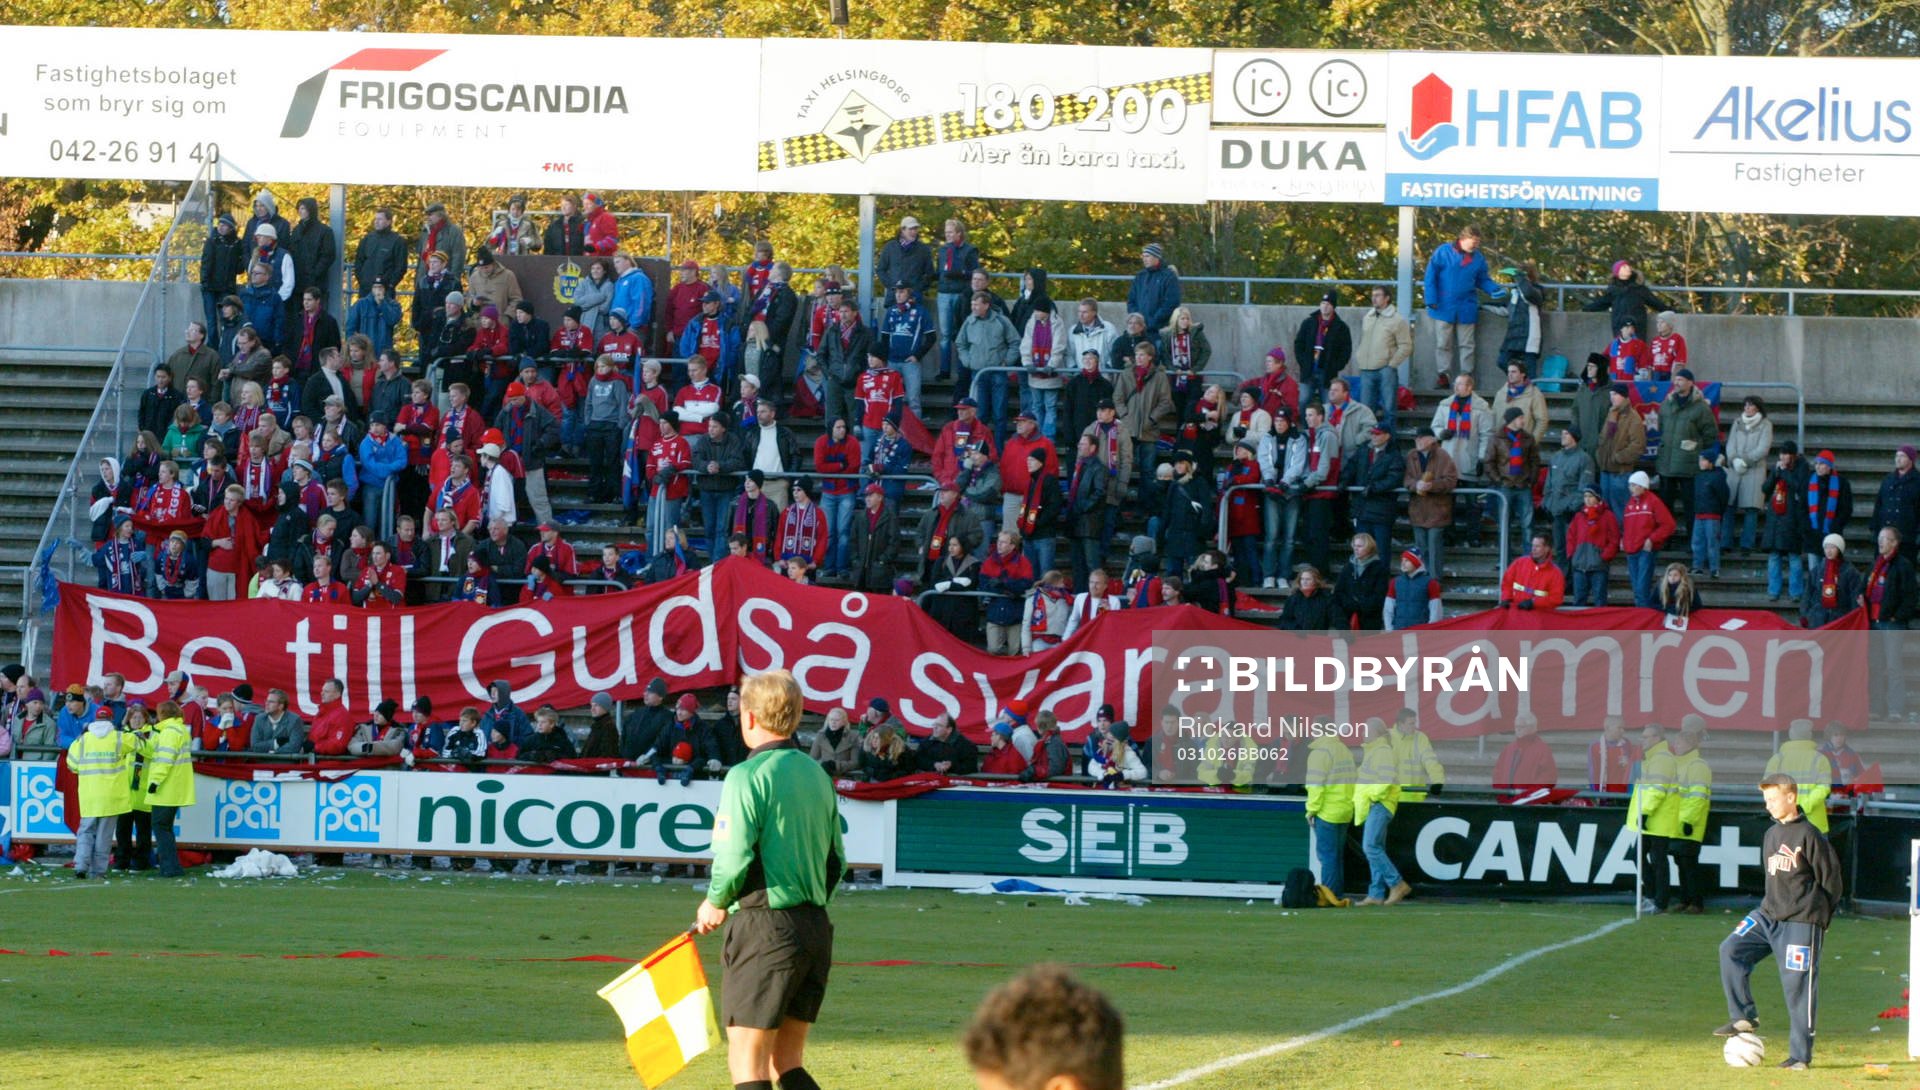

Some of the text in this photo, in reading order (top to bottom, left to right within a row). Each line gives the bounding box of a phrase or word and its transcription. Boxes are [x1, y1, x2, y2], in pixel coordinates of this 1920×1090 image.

[36, 64, 237, 89] Fastighetsbolaget
[44, 95, 226, 119] som bryr sig om
[340, 81, 629, 114] FRIGOSCANDIA
[797, 69, 911, 119] TAXI HELSINGBORG
[959, 83, 1187, 135] 180 200
[338, 121, 506, 138] EQUIPMENT
[1467, 89, 1643, 149] HFAB
[1694, 86, 1912, 143] Akelius
[50, 140, 220, 166] 042-26 91 40
[542, 163, 574, 173] FMC
[958, 142, 1186, 169] Mer än bara taxi.
[1222, 139, 1367, 171] DUKA
[1735, 162, 1865, 185] Fastigheter
[1401, 181, 1643, 203] FASTIGHETSFÖRVALTNING
[86, 593, 248, 709] Be
[286, 614, 417, 715] till
[458, 567, 723, 703] Gud
[737, 591, 872, 711] så
[899, 645, 1295, 732] svarar
[318, 806, 381, 842] pal
[1018, 807, 1190, 867] SEB
